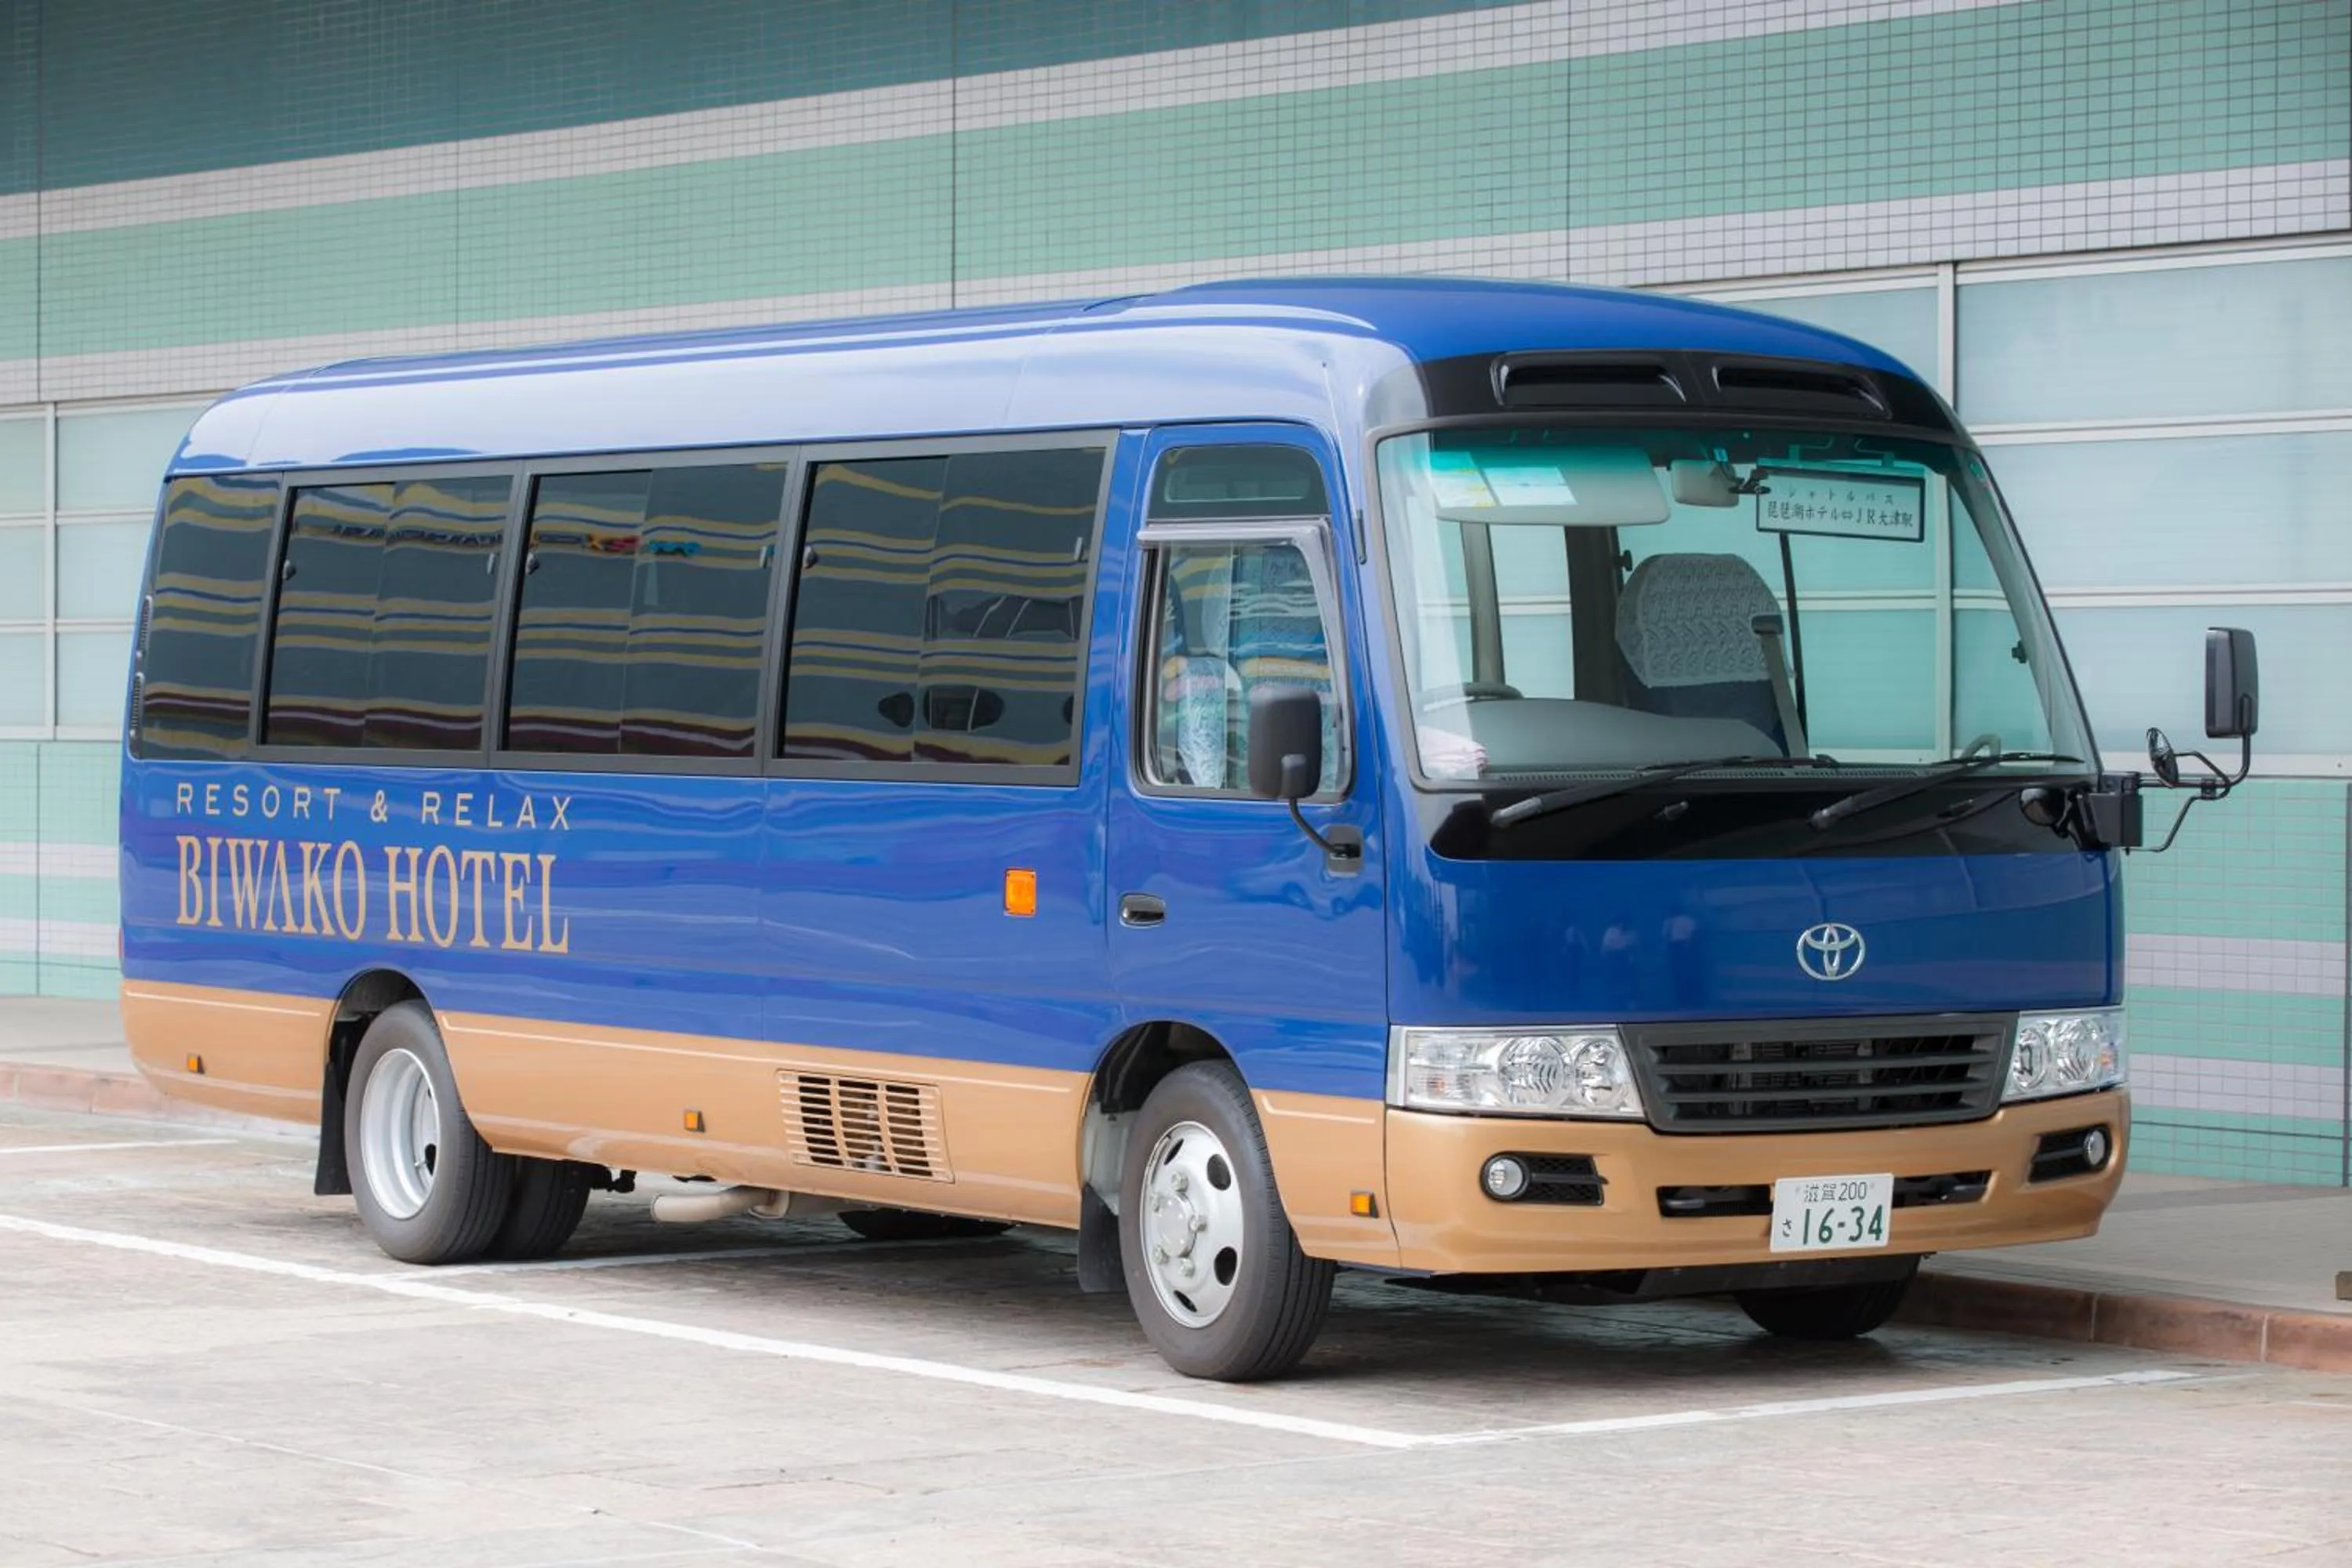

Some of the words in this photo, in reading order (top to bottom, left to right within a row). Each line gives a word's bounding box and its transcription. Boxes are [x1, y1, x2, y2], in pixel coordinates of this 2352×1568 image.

[176, 782, 342, 820] RESORT
[369, 789, 388, 823] &
[422, 791, 572, 830] RELAX
[175, 834, 366, 941] BIWAKO
[383, 844, 569, 954] HOTEL
[1781, 1217, 1792, 1238] さ
[1802, 1203, 1883, 1245] 16-34
